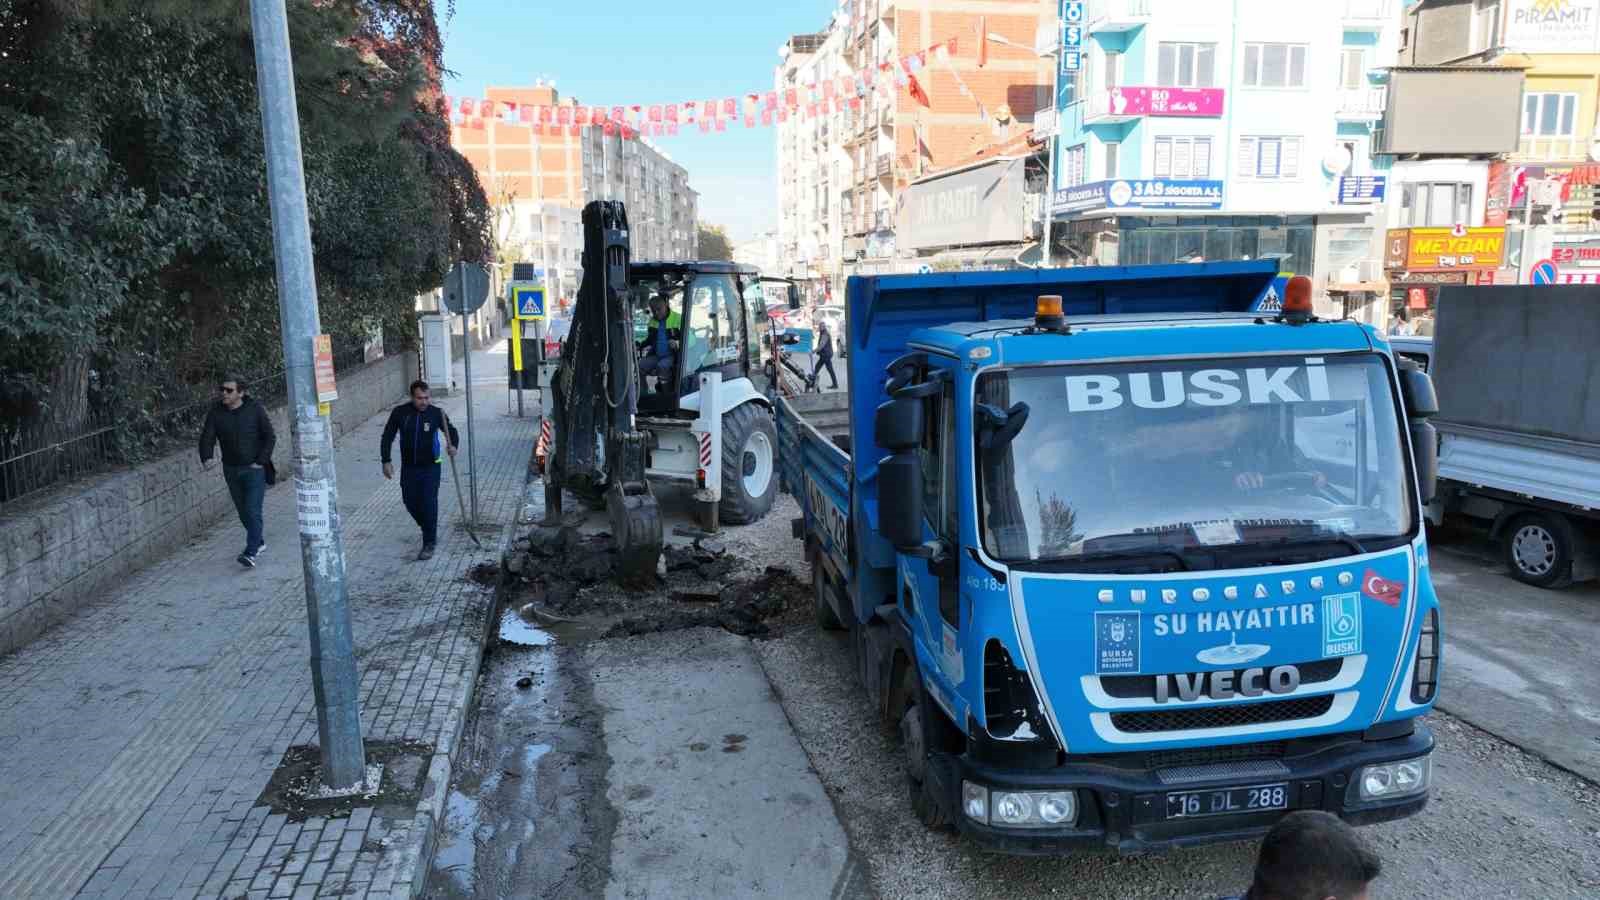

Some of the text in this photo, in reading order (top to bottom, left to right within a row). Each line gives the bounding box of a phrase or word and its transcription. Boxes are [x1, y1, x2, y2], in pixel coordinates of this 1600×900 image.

[1133, 181, 1143, 195] 3
[1144, 181, 1164, 195] AS
[1415, 237, 1501, 256] MEYDAN
[1065, 357, 1330, 412] BUSKİ
[1098, 571, 1354, 604] EUROCARGO
[1154, 603, 1316, 636] SU HAYATTIR
[1155, 665, 1300, 704] IVECO
[1180, 787, 1284, 814] 16 DL 288
